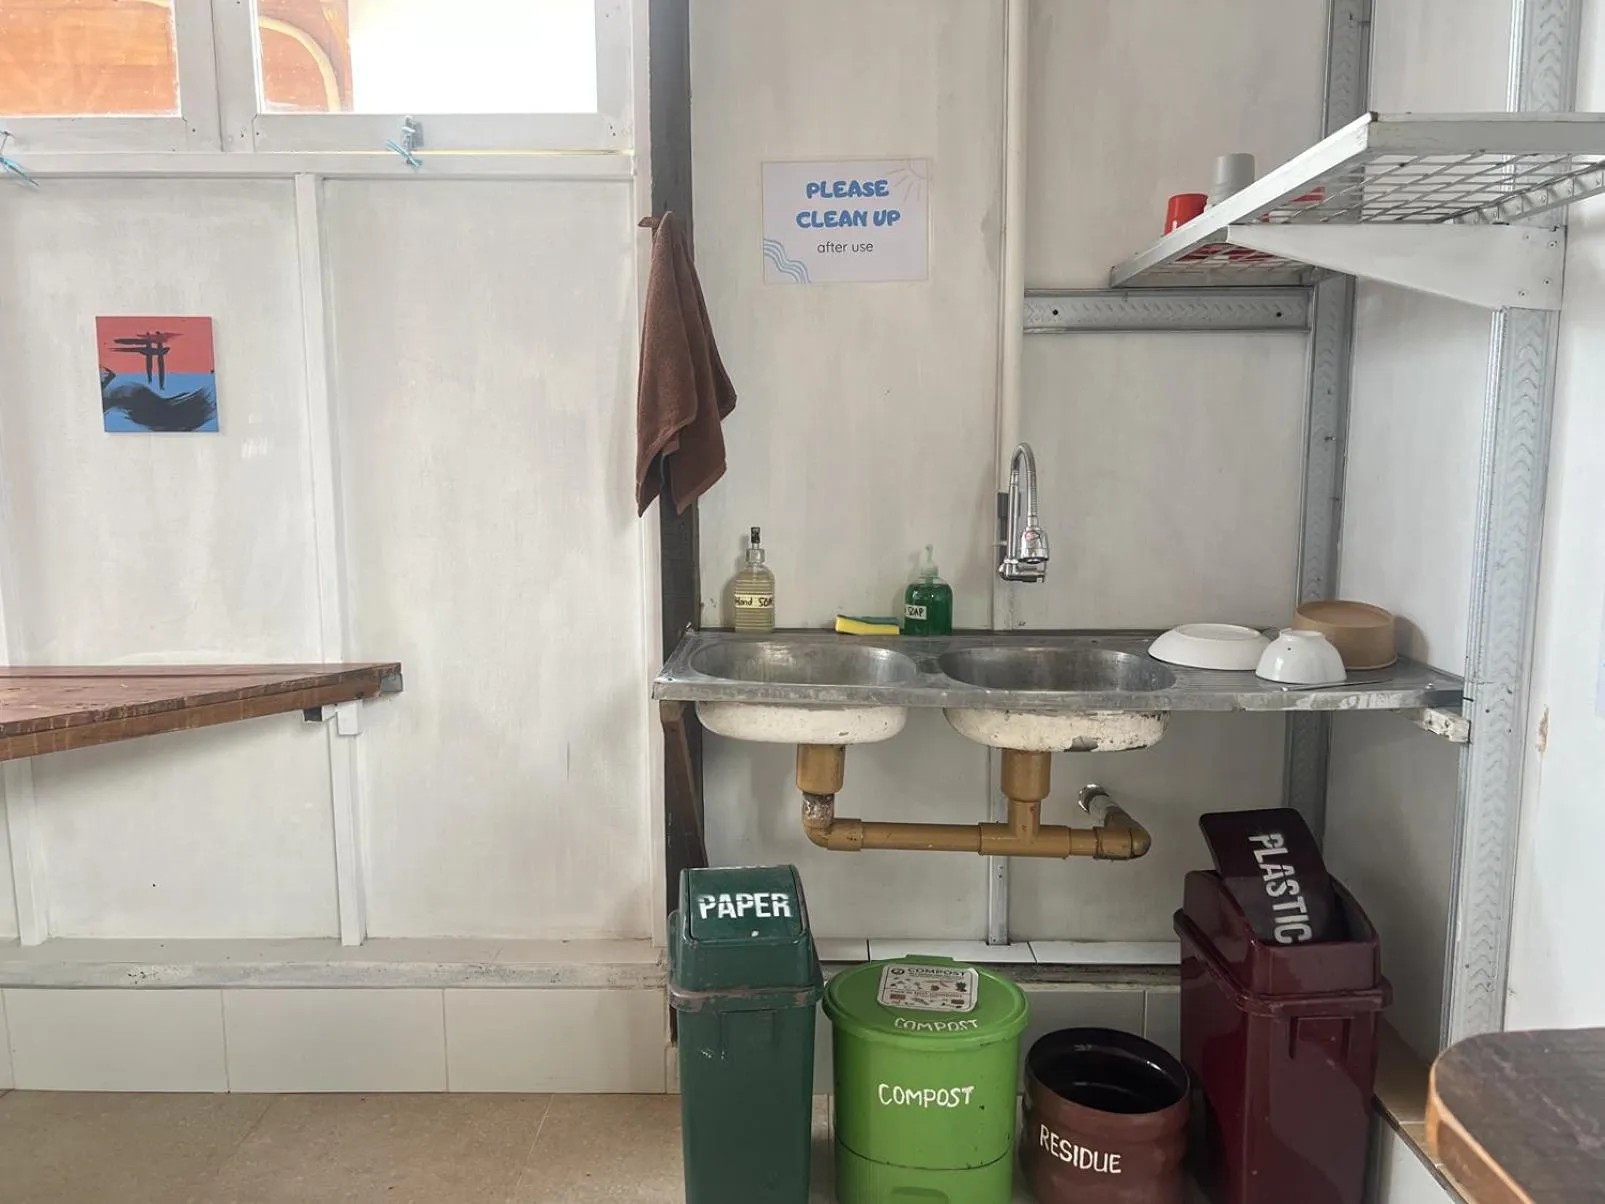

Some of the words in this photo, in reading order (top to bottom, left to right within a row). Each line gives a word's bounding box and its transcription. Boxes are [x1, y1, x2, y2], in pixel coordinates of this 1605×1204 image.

[806, 179, 889, 199] PLEASE
[796, 209, 868, 228] CLEAN
[873, 209, 901, 227] UP
[817, 241, 848, 253] after
[851, 242, 874, 253] use
[908, 606, 925, 617] SOAP
[1248, 833, 1313, 944] PLASTIC
[698, 893, 792, 919] PAPER
[907, 968, 966, 976] COMPOST
[894, 1017, 979, 1032] COMPOST
[879, 1083, 975, 1108] COMPOST
[1040, 1123, 1122, 1174] RESIDUE
